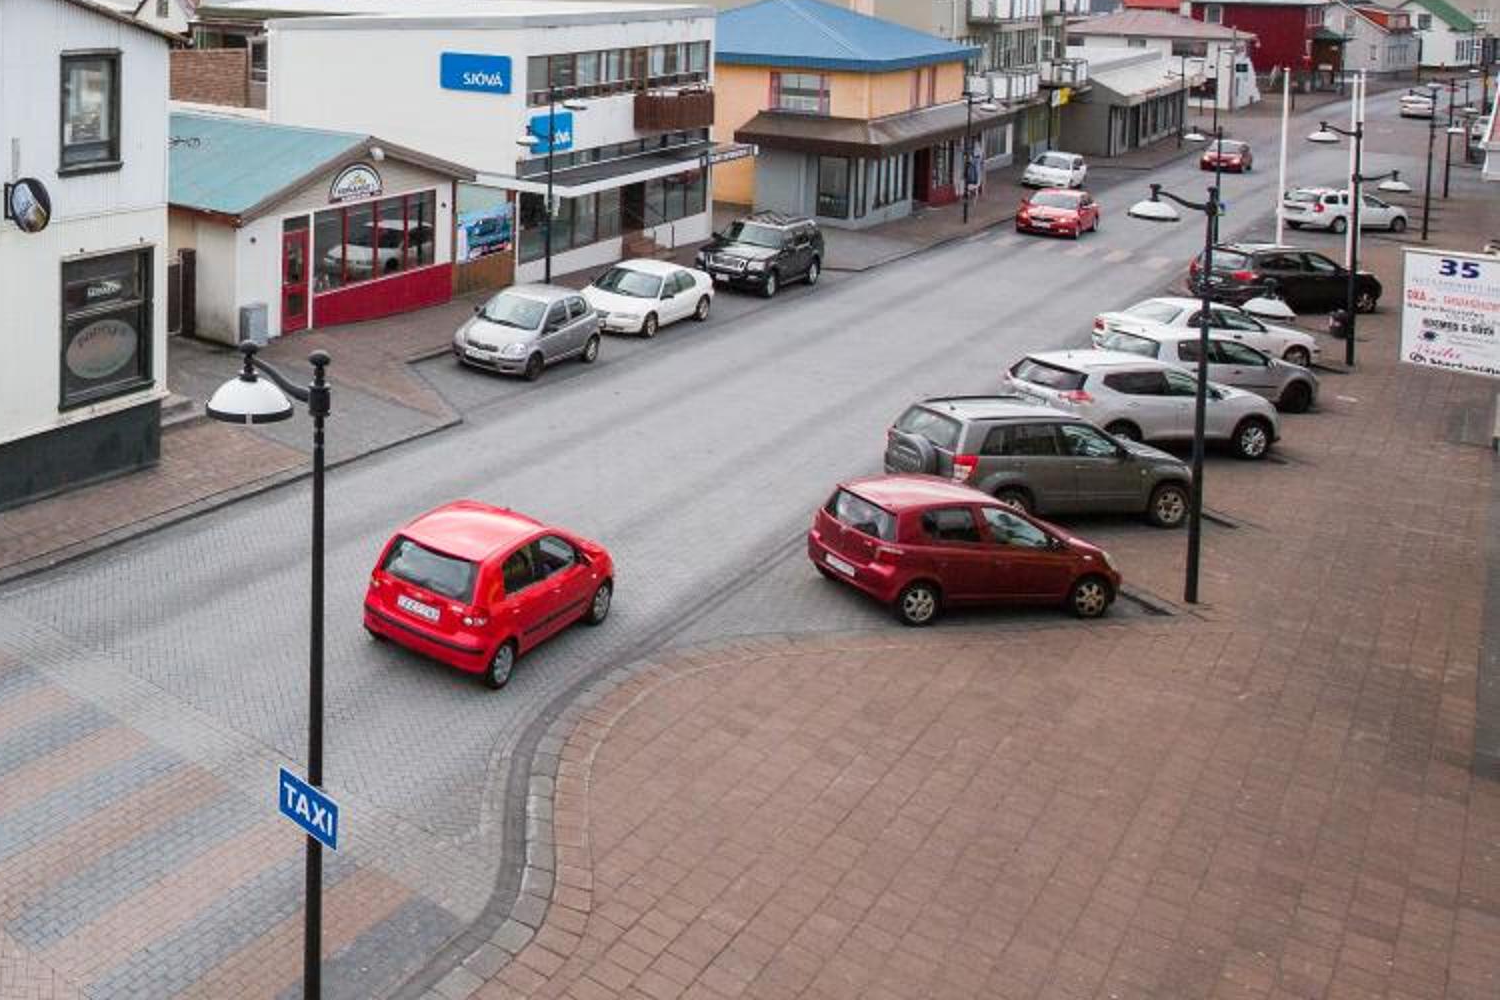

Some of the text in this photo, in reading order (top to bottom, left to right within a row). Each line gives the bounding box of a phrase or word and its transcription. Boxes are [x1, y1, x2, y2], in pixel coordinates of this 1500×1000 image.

[462, 70, 503, 87] SJÓVÁ
[1439, 259, 1480, 279] 35
[283, 781, 333, 837] TAXI
